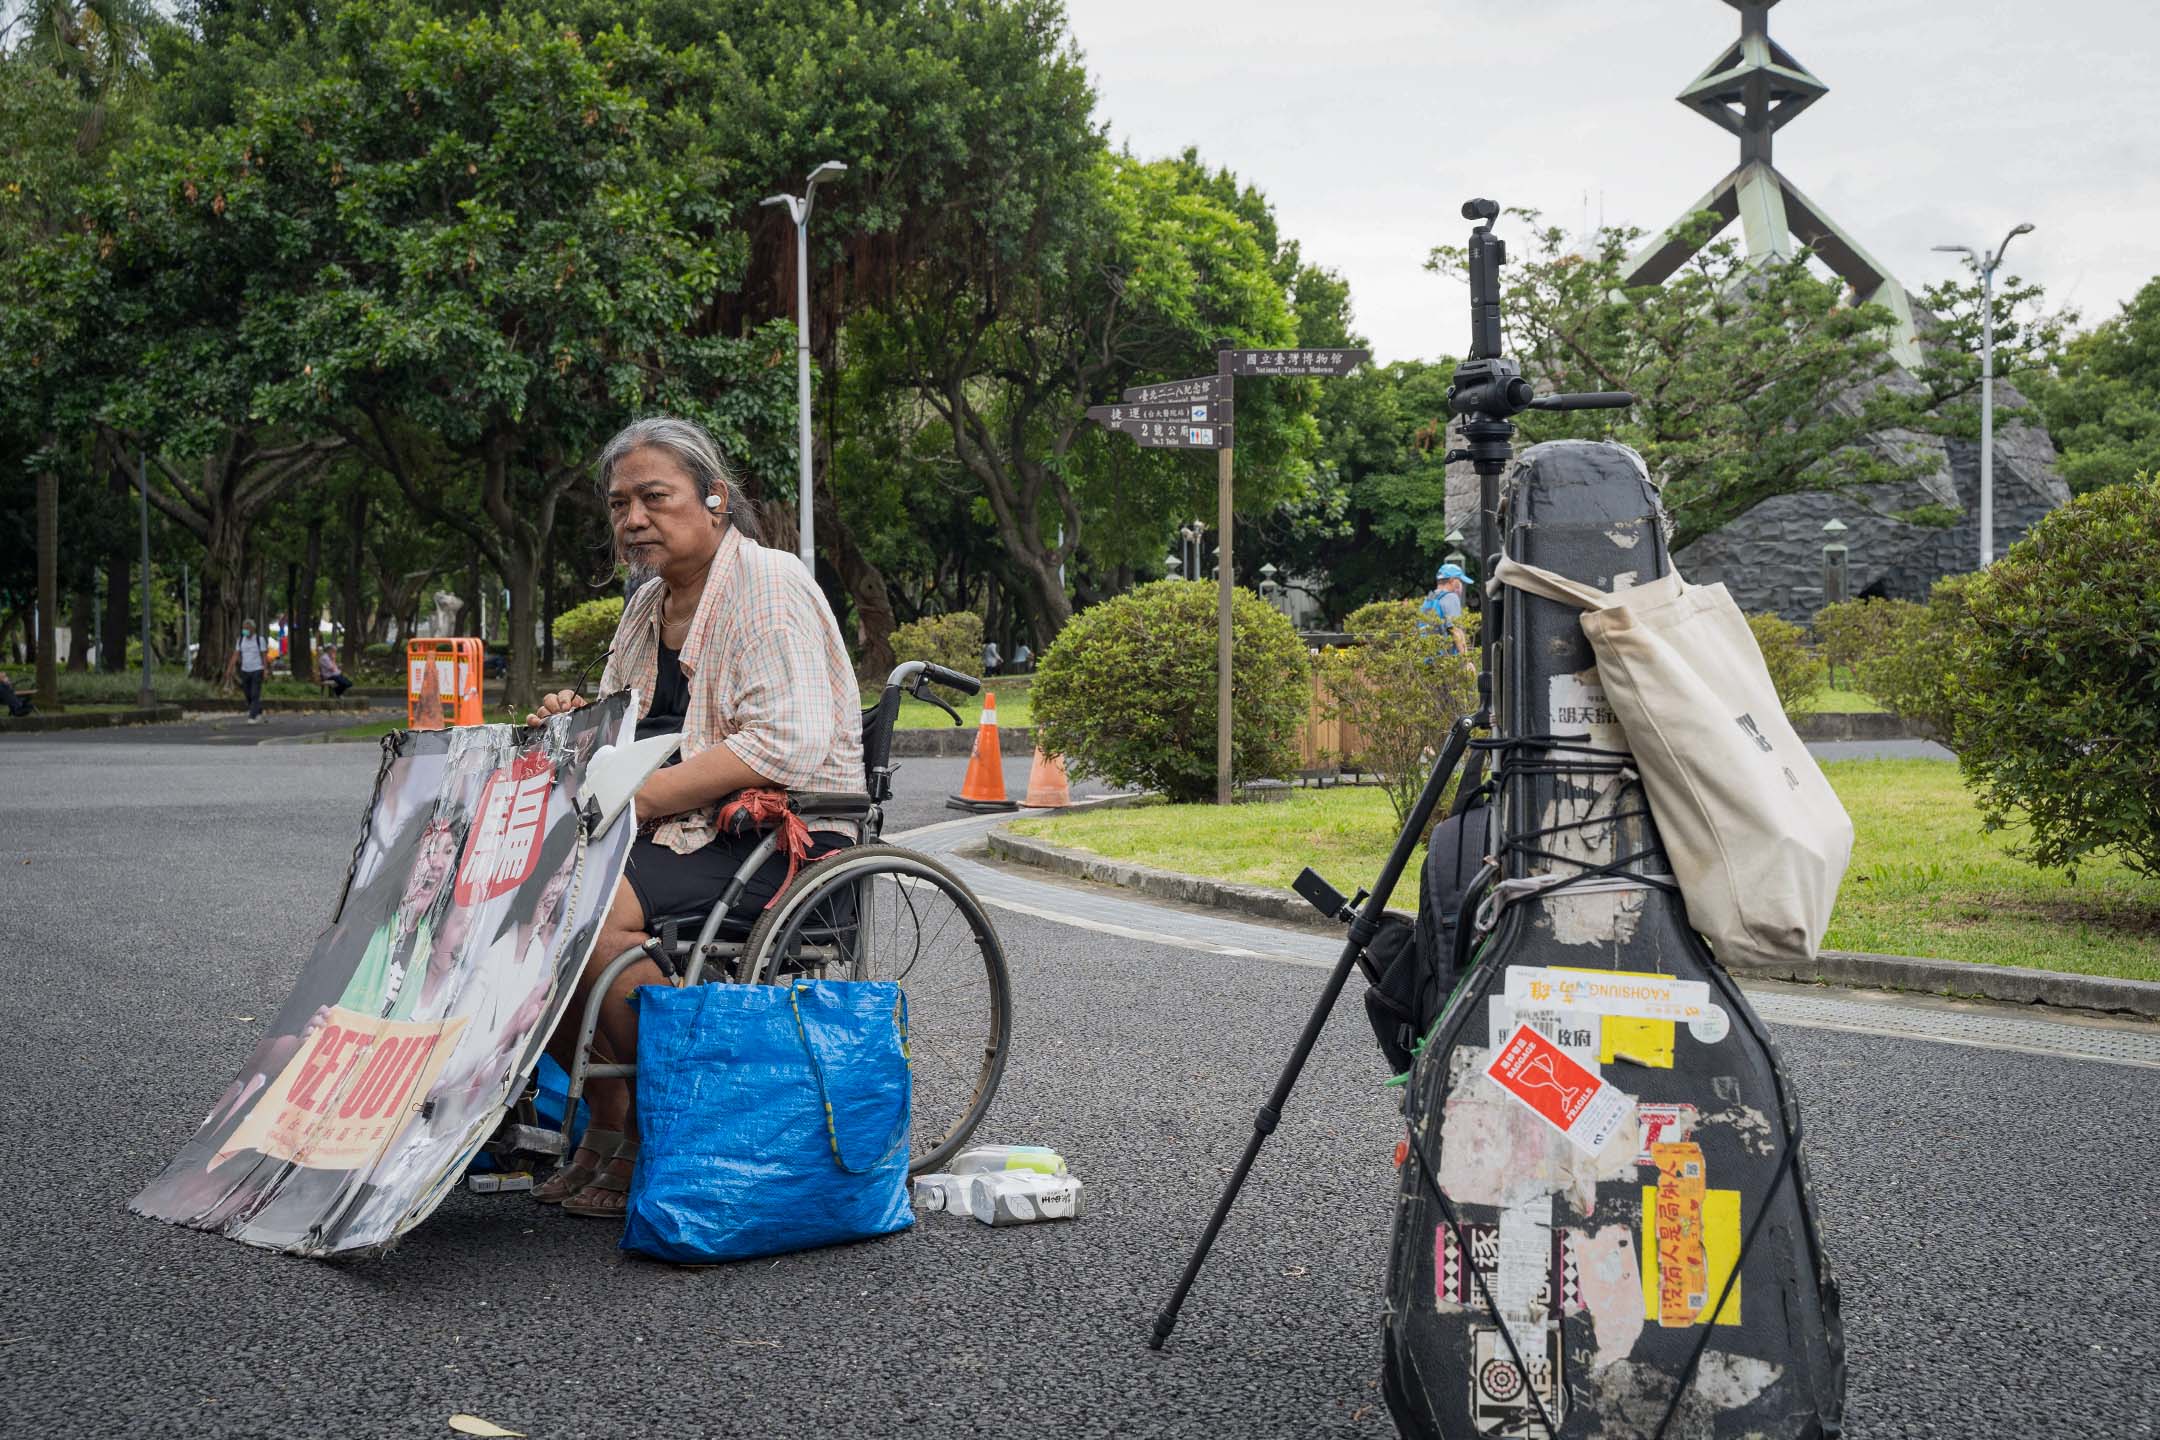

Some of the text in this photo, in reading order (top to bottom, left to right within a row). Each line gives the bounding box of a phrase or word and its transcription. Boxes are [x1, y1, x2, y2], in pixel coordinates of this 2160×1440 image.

[1589, 982, 1671, 1001] KAOHSIUNG
[287, 1025, 441, 1120] GET OUT
